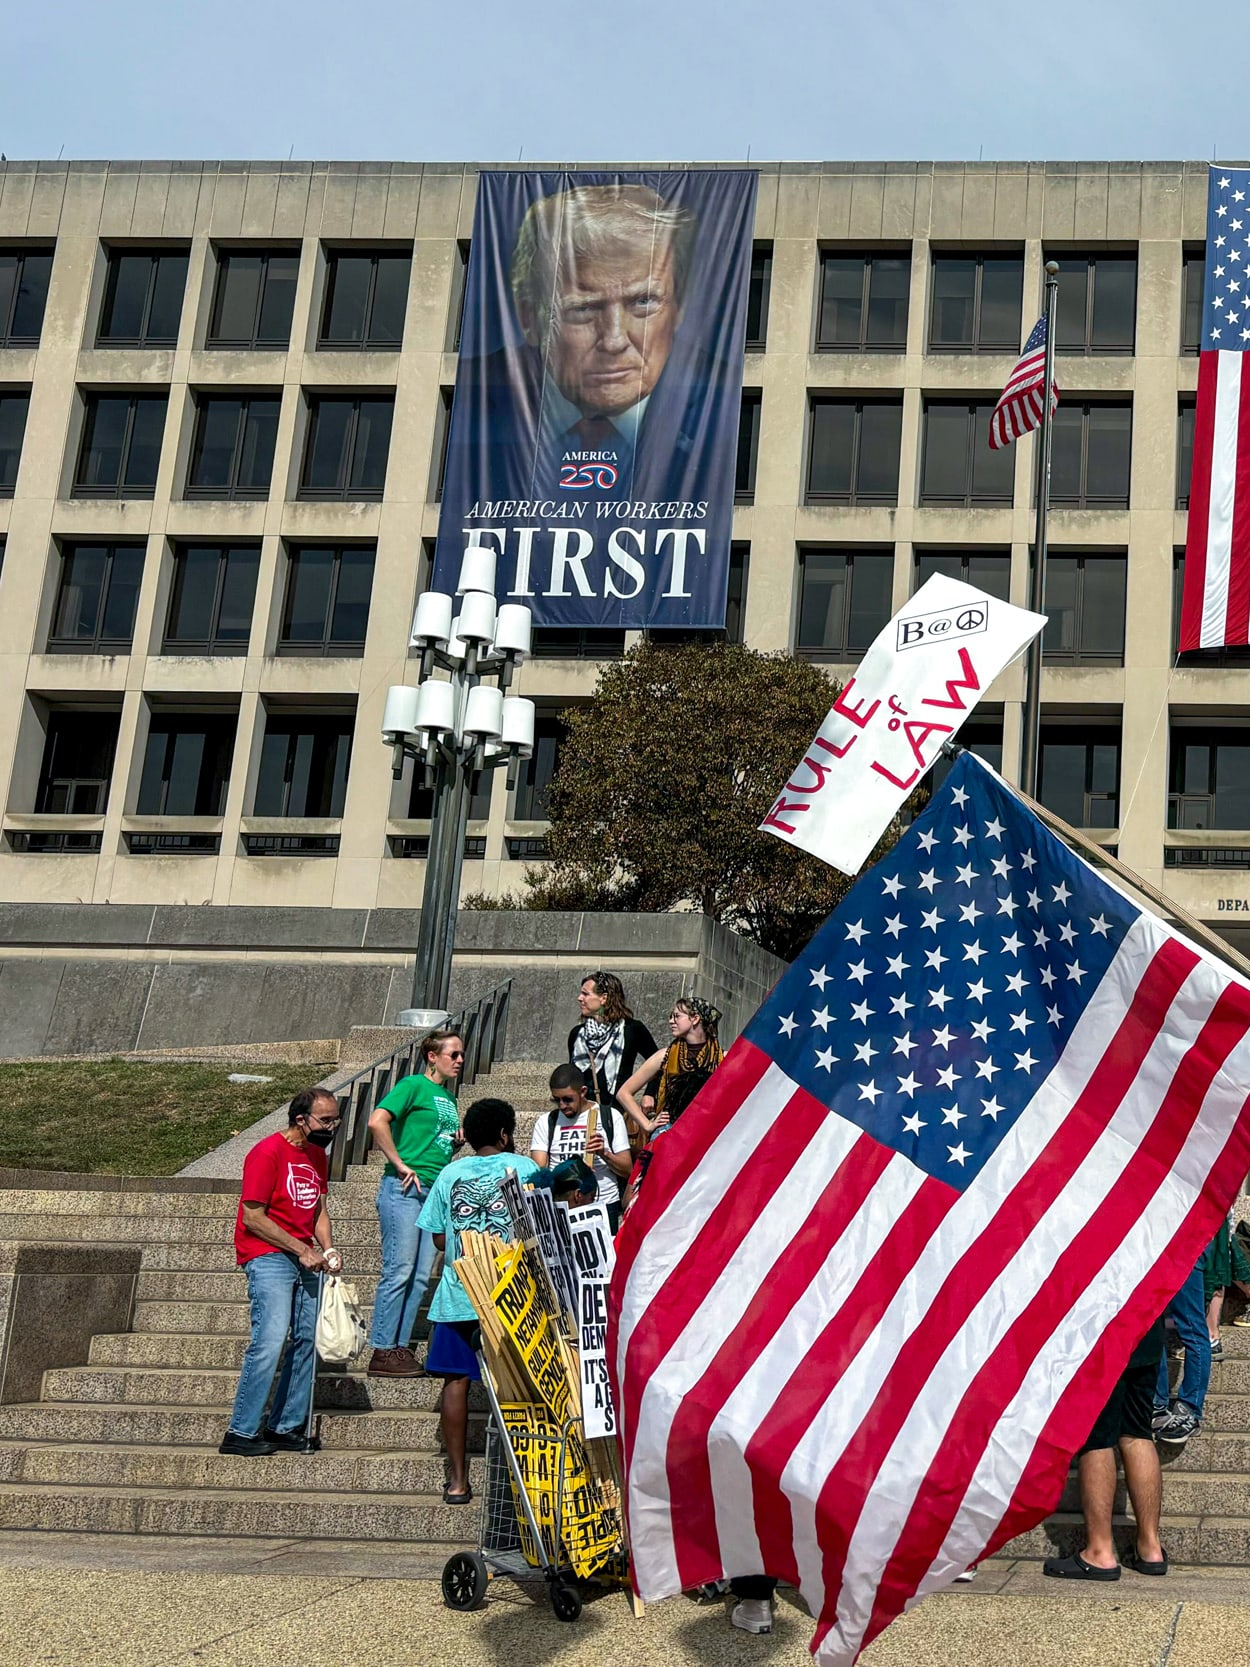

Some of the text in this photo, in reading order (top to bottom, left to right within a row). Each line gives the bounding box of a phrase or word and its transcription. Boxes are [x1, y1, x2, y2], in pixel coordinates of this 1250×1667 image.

[562, 451, 617, 461] AMERICA
[464, 500, 709, 519] AMERICAN WORKERS
[870, 646, 981, 791] LAW
[887, 694, 908, 732] of
[762, 677, 882, 835] RULE
[495, 1260, 532, 1326] TRUMP
[584, 1358, 608, 1385] IT'S
